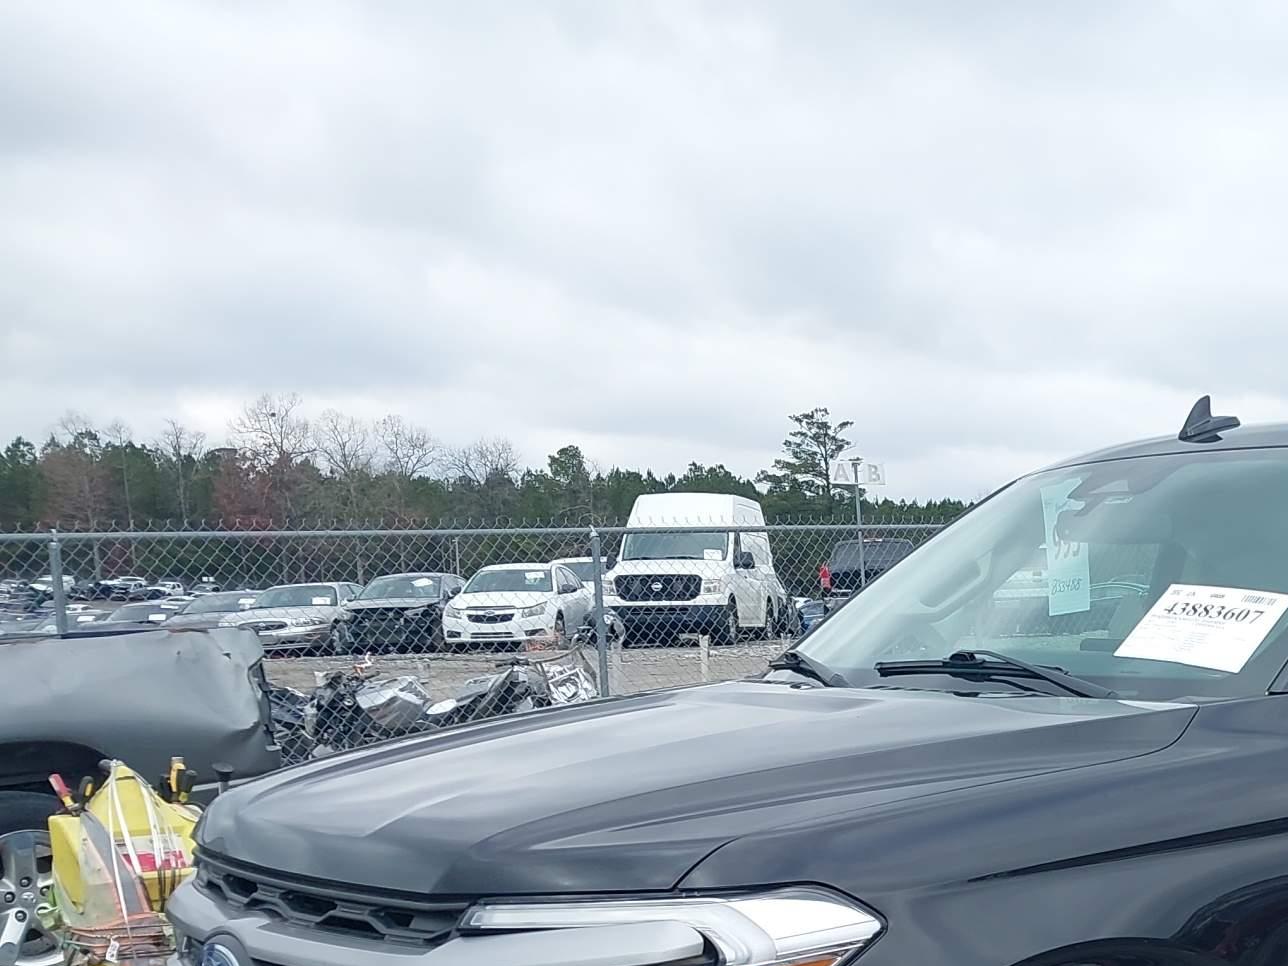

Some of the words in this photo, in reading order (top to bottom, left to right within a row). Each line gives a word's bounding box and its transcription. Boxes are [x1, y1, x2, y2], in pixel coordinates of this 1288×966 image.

[833, 463, 850, 482] A
[868, 464, 881, 482] B
[1163, 600, 1266, 625] 43883607
